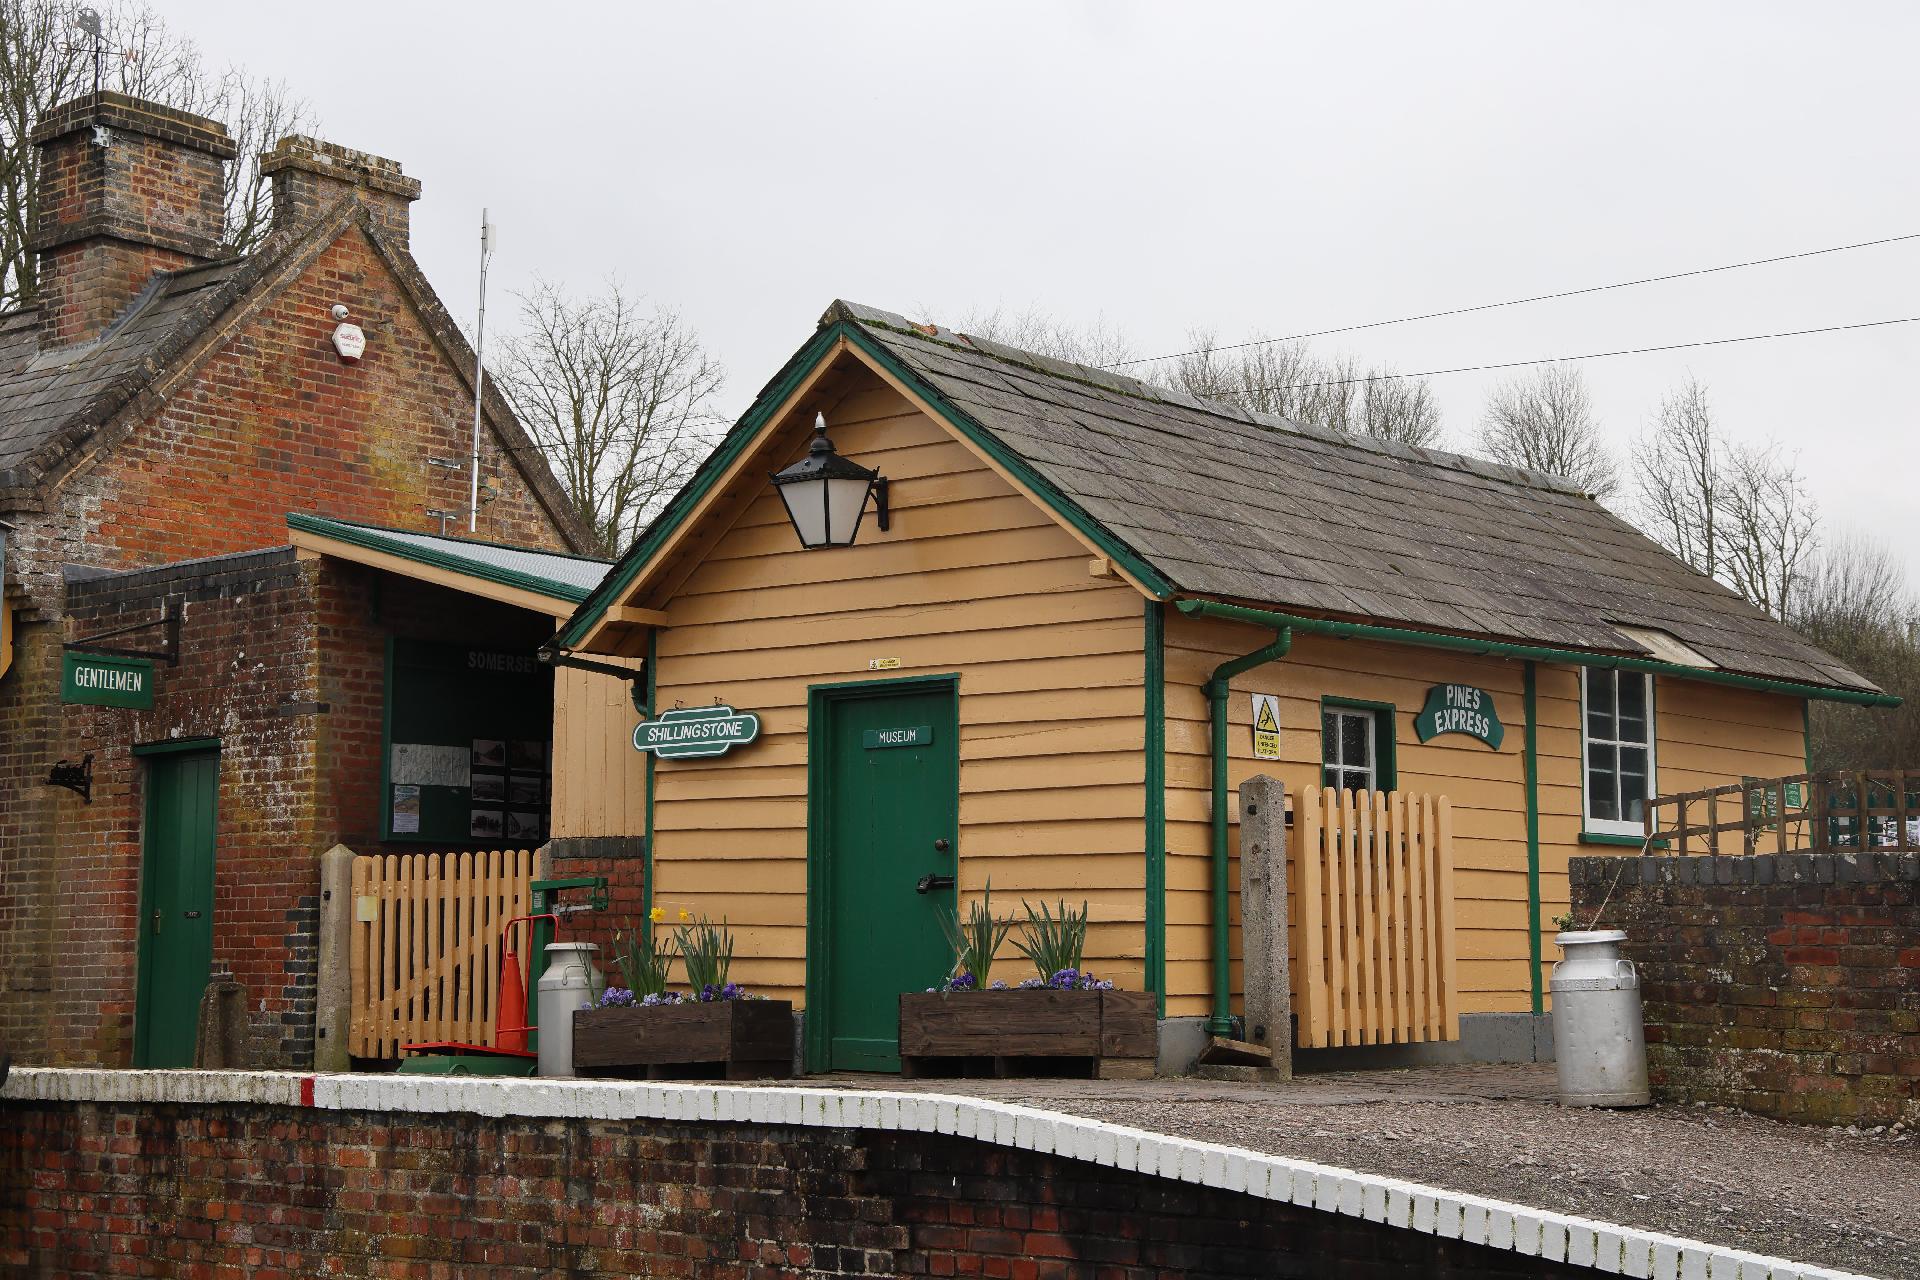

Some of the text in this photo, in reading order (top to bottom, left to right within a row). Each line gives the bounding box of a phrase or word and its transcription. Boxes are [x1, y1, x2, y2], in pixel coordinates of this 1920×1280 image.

[75, 666, 142, 692] GENTLEMEN
[1446, 685, 1481, 710] PINES
[647, 721, 744, 742] SHILLINGSTONE
[1434, 708, 1489, 738] EXPRESS
[879, 729, 916, 743] MUSEUM
